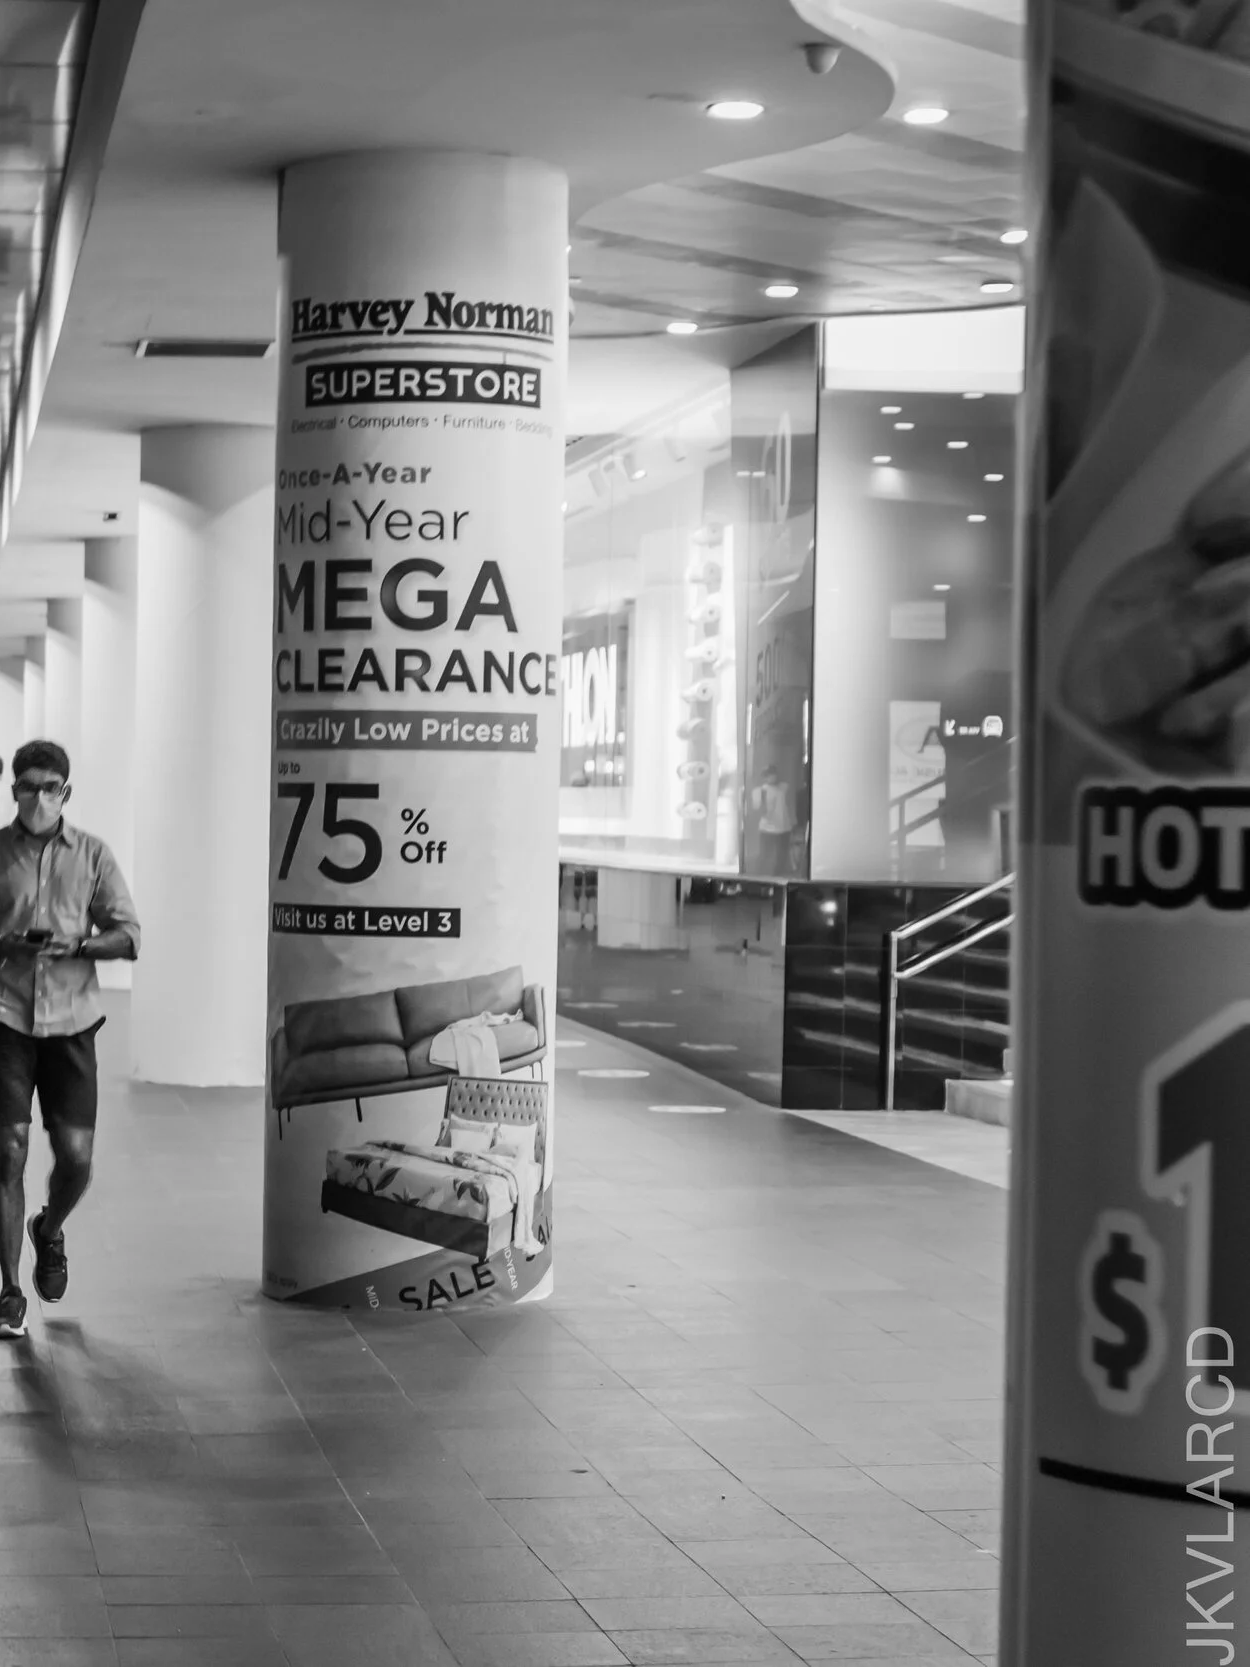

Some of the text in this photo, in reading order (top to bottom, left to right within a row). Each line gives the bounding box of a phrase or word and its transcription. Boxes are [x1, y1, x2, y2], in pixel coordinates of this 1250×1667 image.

[291, 291, 553, 336] Harvey Norman
[311, 367, 538, 403] SUPERSTORE
[348, 415, 429, 431] Computers
[443, 414, 506, 430] Furniture
[278, 462, 432, 490] Once-A-Year
[277, 499, 470, 545] Mid-Year
[277, 558, 519, 634] MEGA
[276, 648, 557, 696] CLEARANCE
[280, 717, 530, 744] Crazily Low Prices at
[278, 761, 301, 776] Up to
[277, 782, 383, 884] 75
[400, 841, 448, 864] Off
[1087, 804, 1250, 891] HOT
[274, 906, 452, 933] Visit us at Level 3
[398, 1258, 496, 1311] SALE
